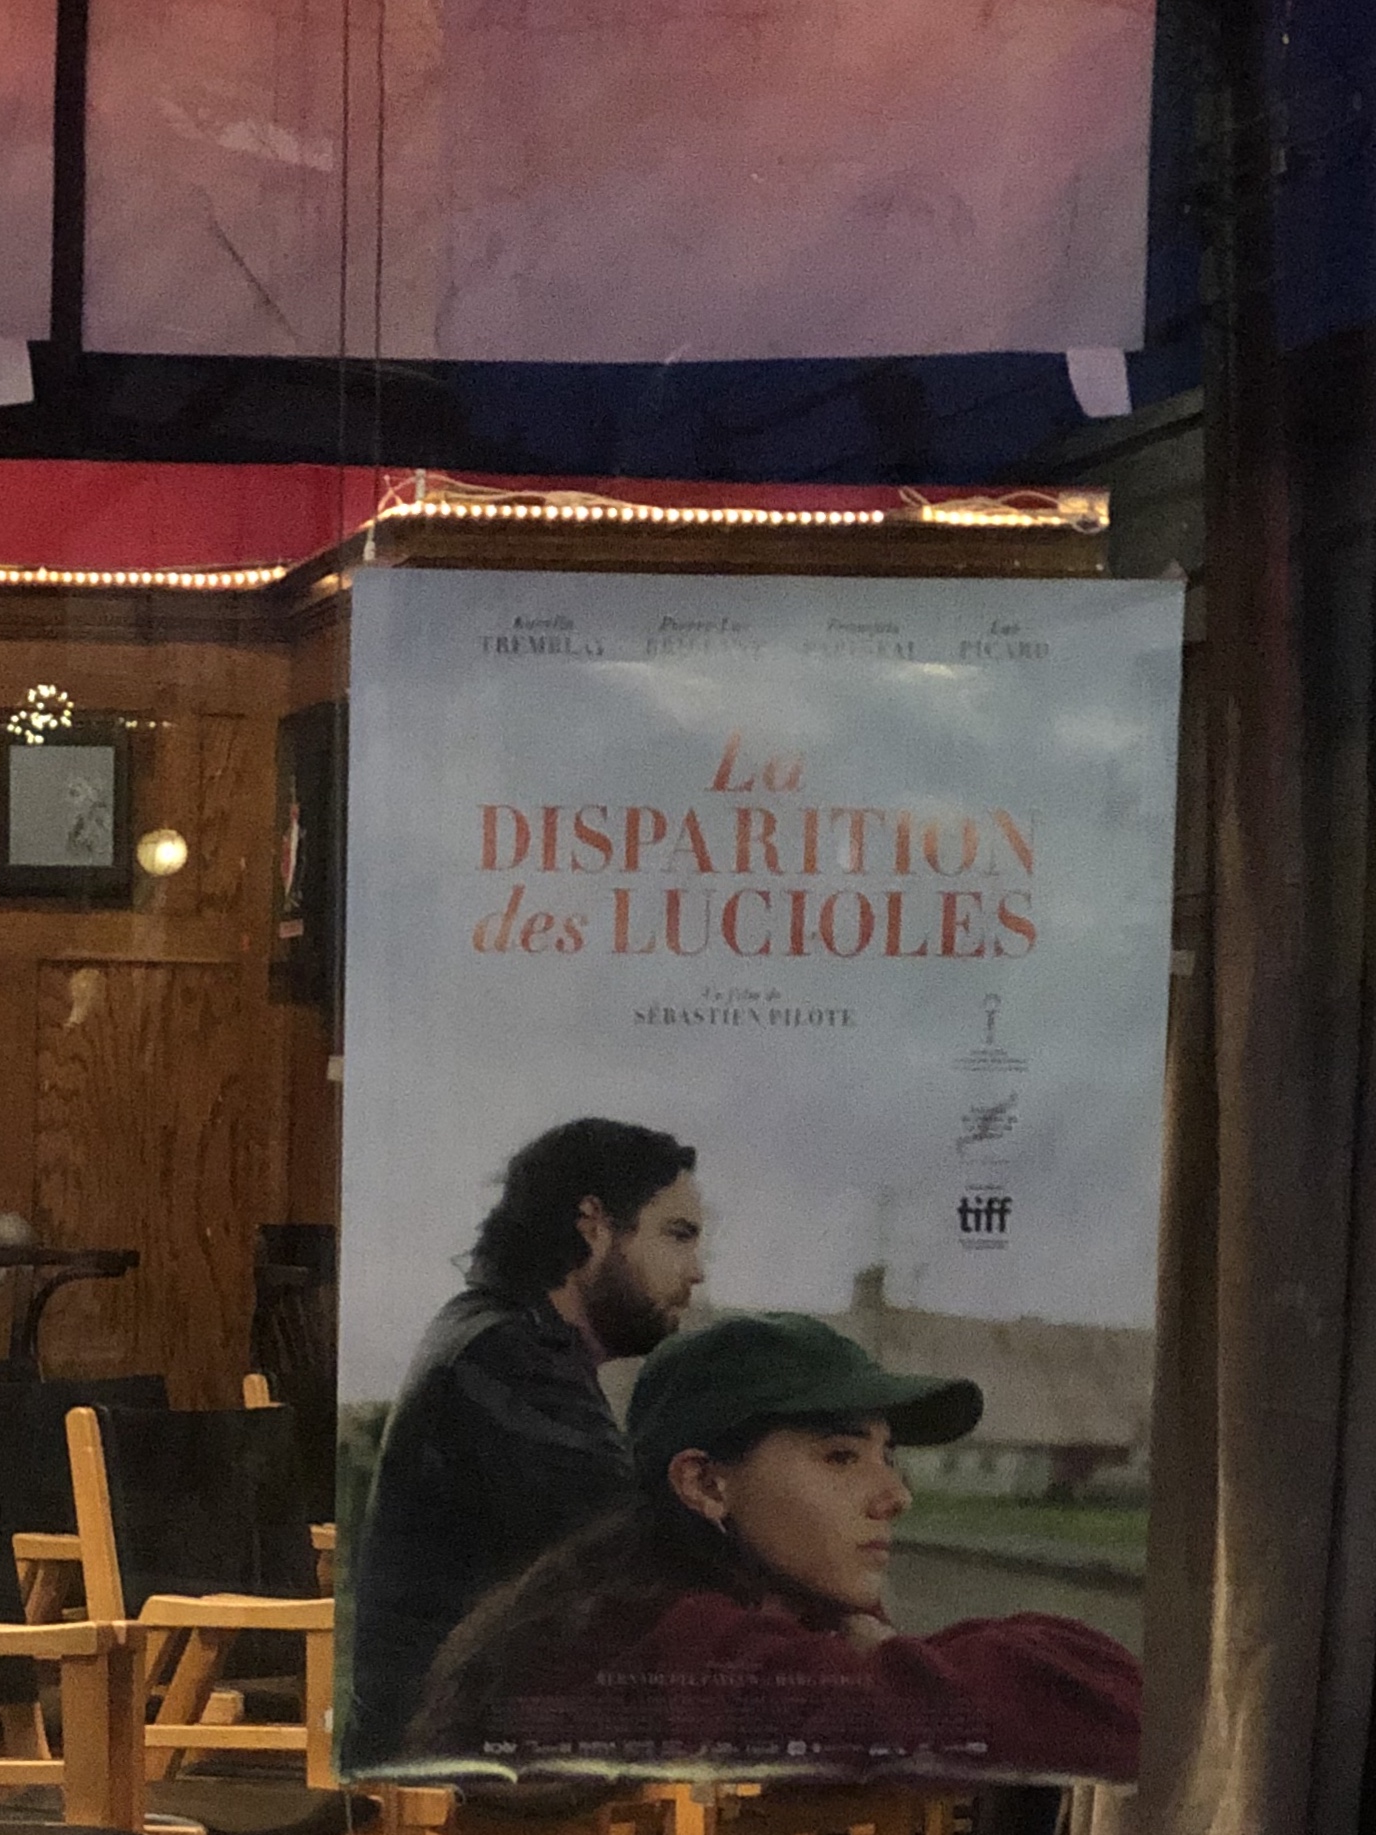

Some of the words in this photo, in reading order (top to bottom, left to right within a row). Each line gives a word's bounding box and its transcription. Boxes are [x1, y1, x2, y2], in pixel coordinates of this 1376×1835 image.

[706, 731, 807, 793] La
[475, 803, 1045, 876] DISPARITION
[471, 884, 589, 955] des
[610, 887, 1040, 959] LUCIOLES
[768, 1007, 858, 1028] PILOTE
[957, 1196, 1013, 1233] tiff
